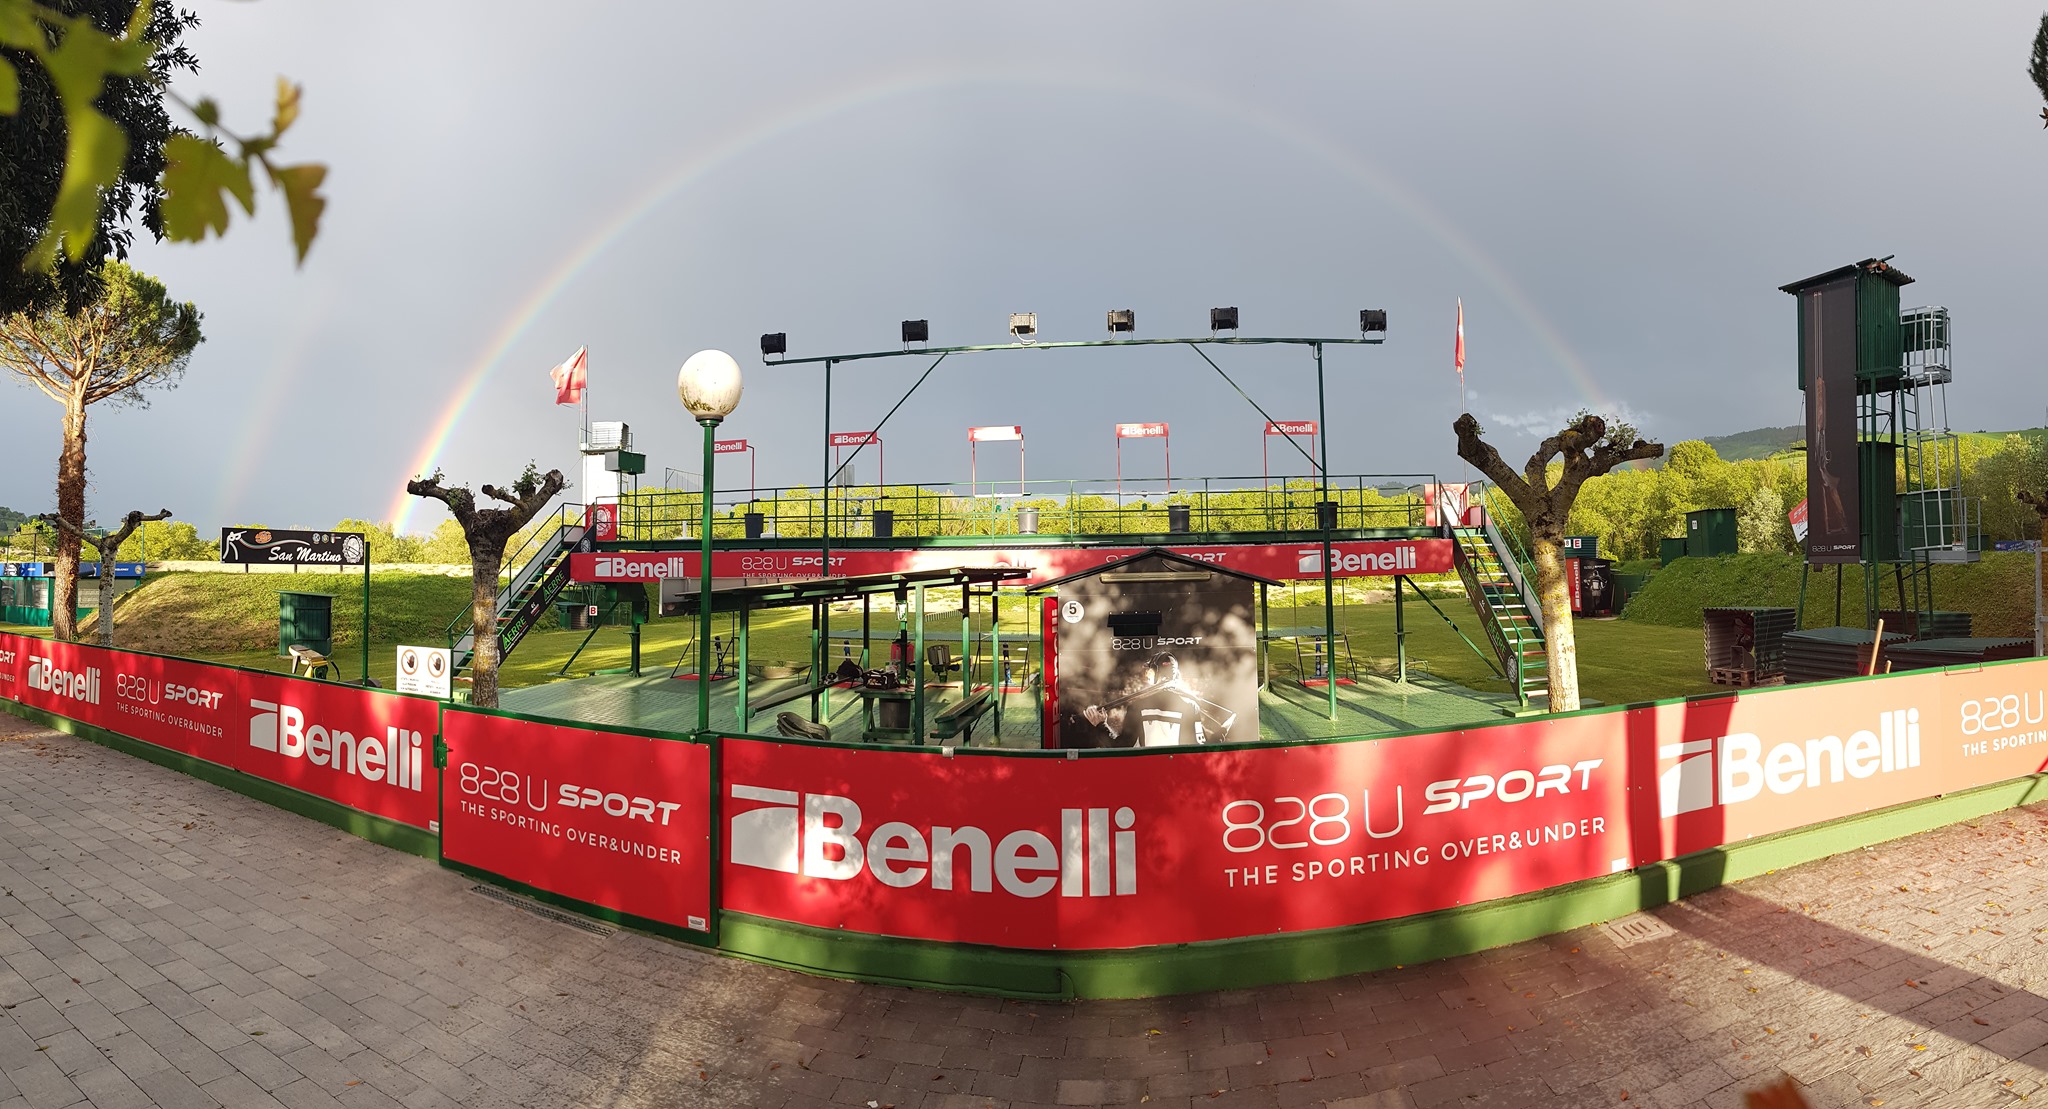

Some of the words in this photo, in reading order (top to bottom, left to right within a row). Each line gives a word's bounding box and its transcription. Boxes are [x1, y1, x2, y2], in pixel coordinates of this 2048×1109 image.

[843, 434, 873, 443] Benelli
[1129, 426, 1164, 435] Benelli
[1280, 424, 1313, 433] Benelli
[714, 442, 742, 451] Benelli
[268, 546, 293, 561] San
[296, 546, 342, 562] Martino
[612, 557, 684, 578] Benelli
[742, 557, 773, 570] 828
[776, 557, 787, 570] U
[1180, 552, 1227, 562] ORT
[1323, 546, 1416, 572] Benelli
[590, 606, 596, 615] B
[1069, 602, 1077, 615] 5
[502, 616, 527, 651] AERRE
[1112, 638, 1140, 650] 828
[1143, 638, 1153, 650] U
[1157, 636, 1203, 646] SPORT
[41, 657, 100, 705] Benelli
[117, 673, 146, 702] 828
[148, 679, 160, 705] U
[164, 683, 224, 710] SPORT
[117, 701, 129, 713] THE
[131, 705, 166, 722] SPORTING
[168, 715, 223, 738] OVER&UNDER
[1960, 694, 2020, 735] 828
[2024, 690, 2044, 724] U
[279, 704, 422, 792] Benelli
[1717, 707, 1920, 805] Benelli
[1962, 741, 1988, 757] THE
[1993, 730, 2048, 751] SPORTIN
[460, 762, 520, 804] 828
[527, 775, 547, 812] U
[557, 783, 682, 826] SPORT
[1221, 792, 1351, 854] 828
[1364, 785, 1403, 839] U
[1422, 758, 1604, 815] SPORT
[461, 800, 485, 817] THE
[491, 808, 560, 837] SPORTING
[566, 827, 681, 865] OVER&UNDER
[803, 792, 1137, 898] Benelli
[1224, 864, 1278, 888] THE
[1291, 846, 1429, 883] SPORTING
[1440, 817, 1605, 862] OVER&UNDER
